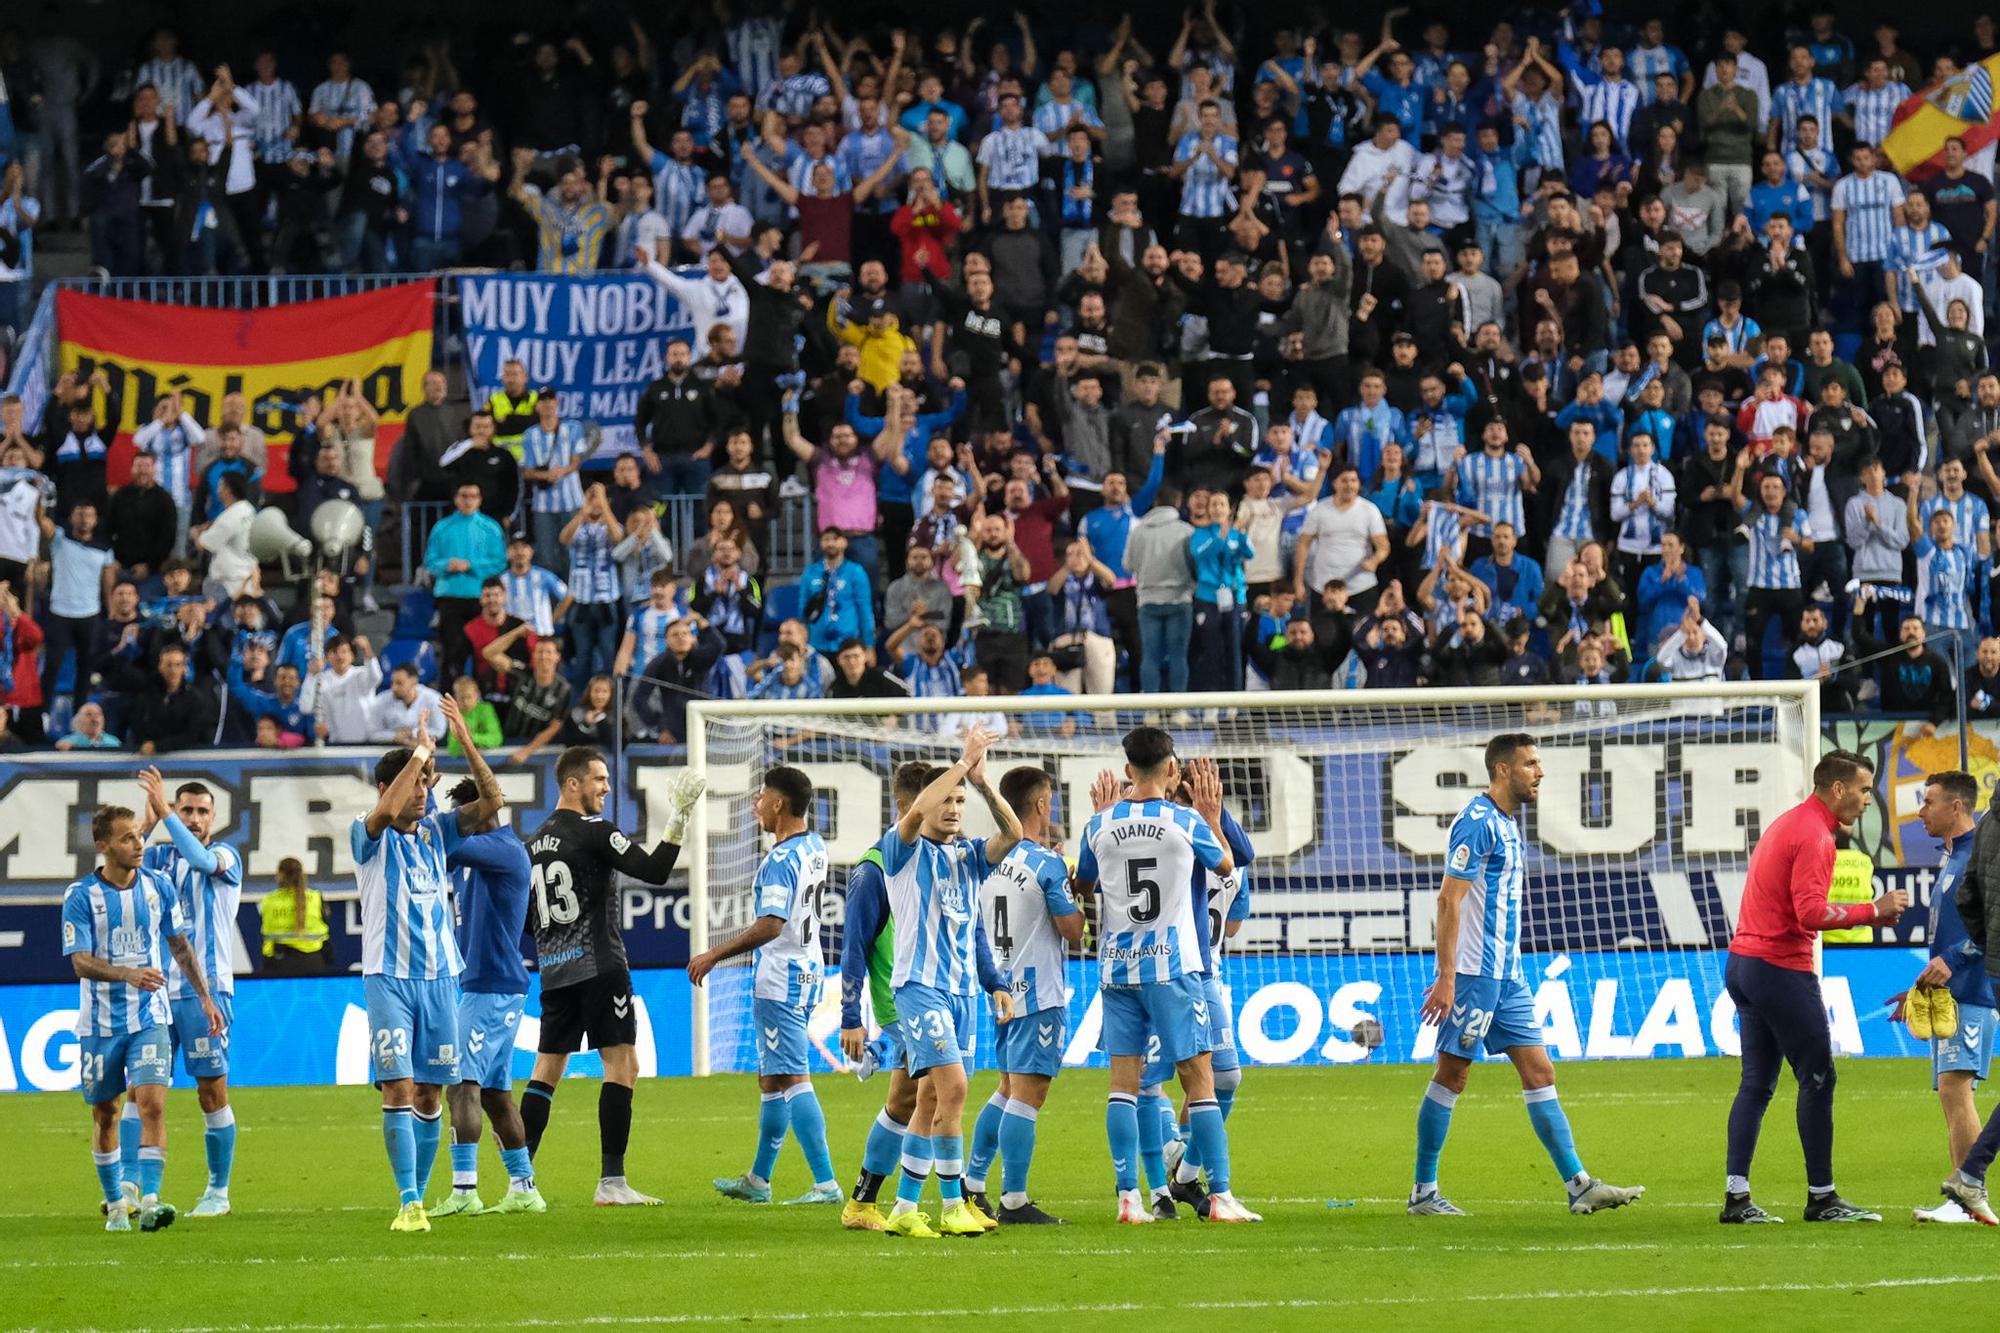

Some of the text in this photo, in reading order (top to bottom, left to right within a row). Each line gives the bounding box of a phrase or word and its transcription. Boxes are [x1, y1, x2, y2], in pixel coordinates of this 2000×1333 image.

[462, 278, 556, 335] MUY
[496, 334, 586, 386] MUY
[592, 338, 675, 386] LEA
[1392, 743, 1805, 857] SUR
[1110, 823, 1166, 847] JUANDE
[530, 860, 581, 930] 13
[1126, 857, 1161, 925] 5
[994, 895, 1014, 959] 4
[538, 945, 585, 968] NAHAVIS
[798, 973, 820, 985] BEN
[1007, 980, 1029, 993] VIS
[1464, 1007, 1494, 1038] 20
[376, 1027, 407, 1058] 23
[83, 1052, 105, 1082] 21
